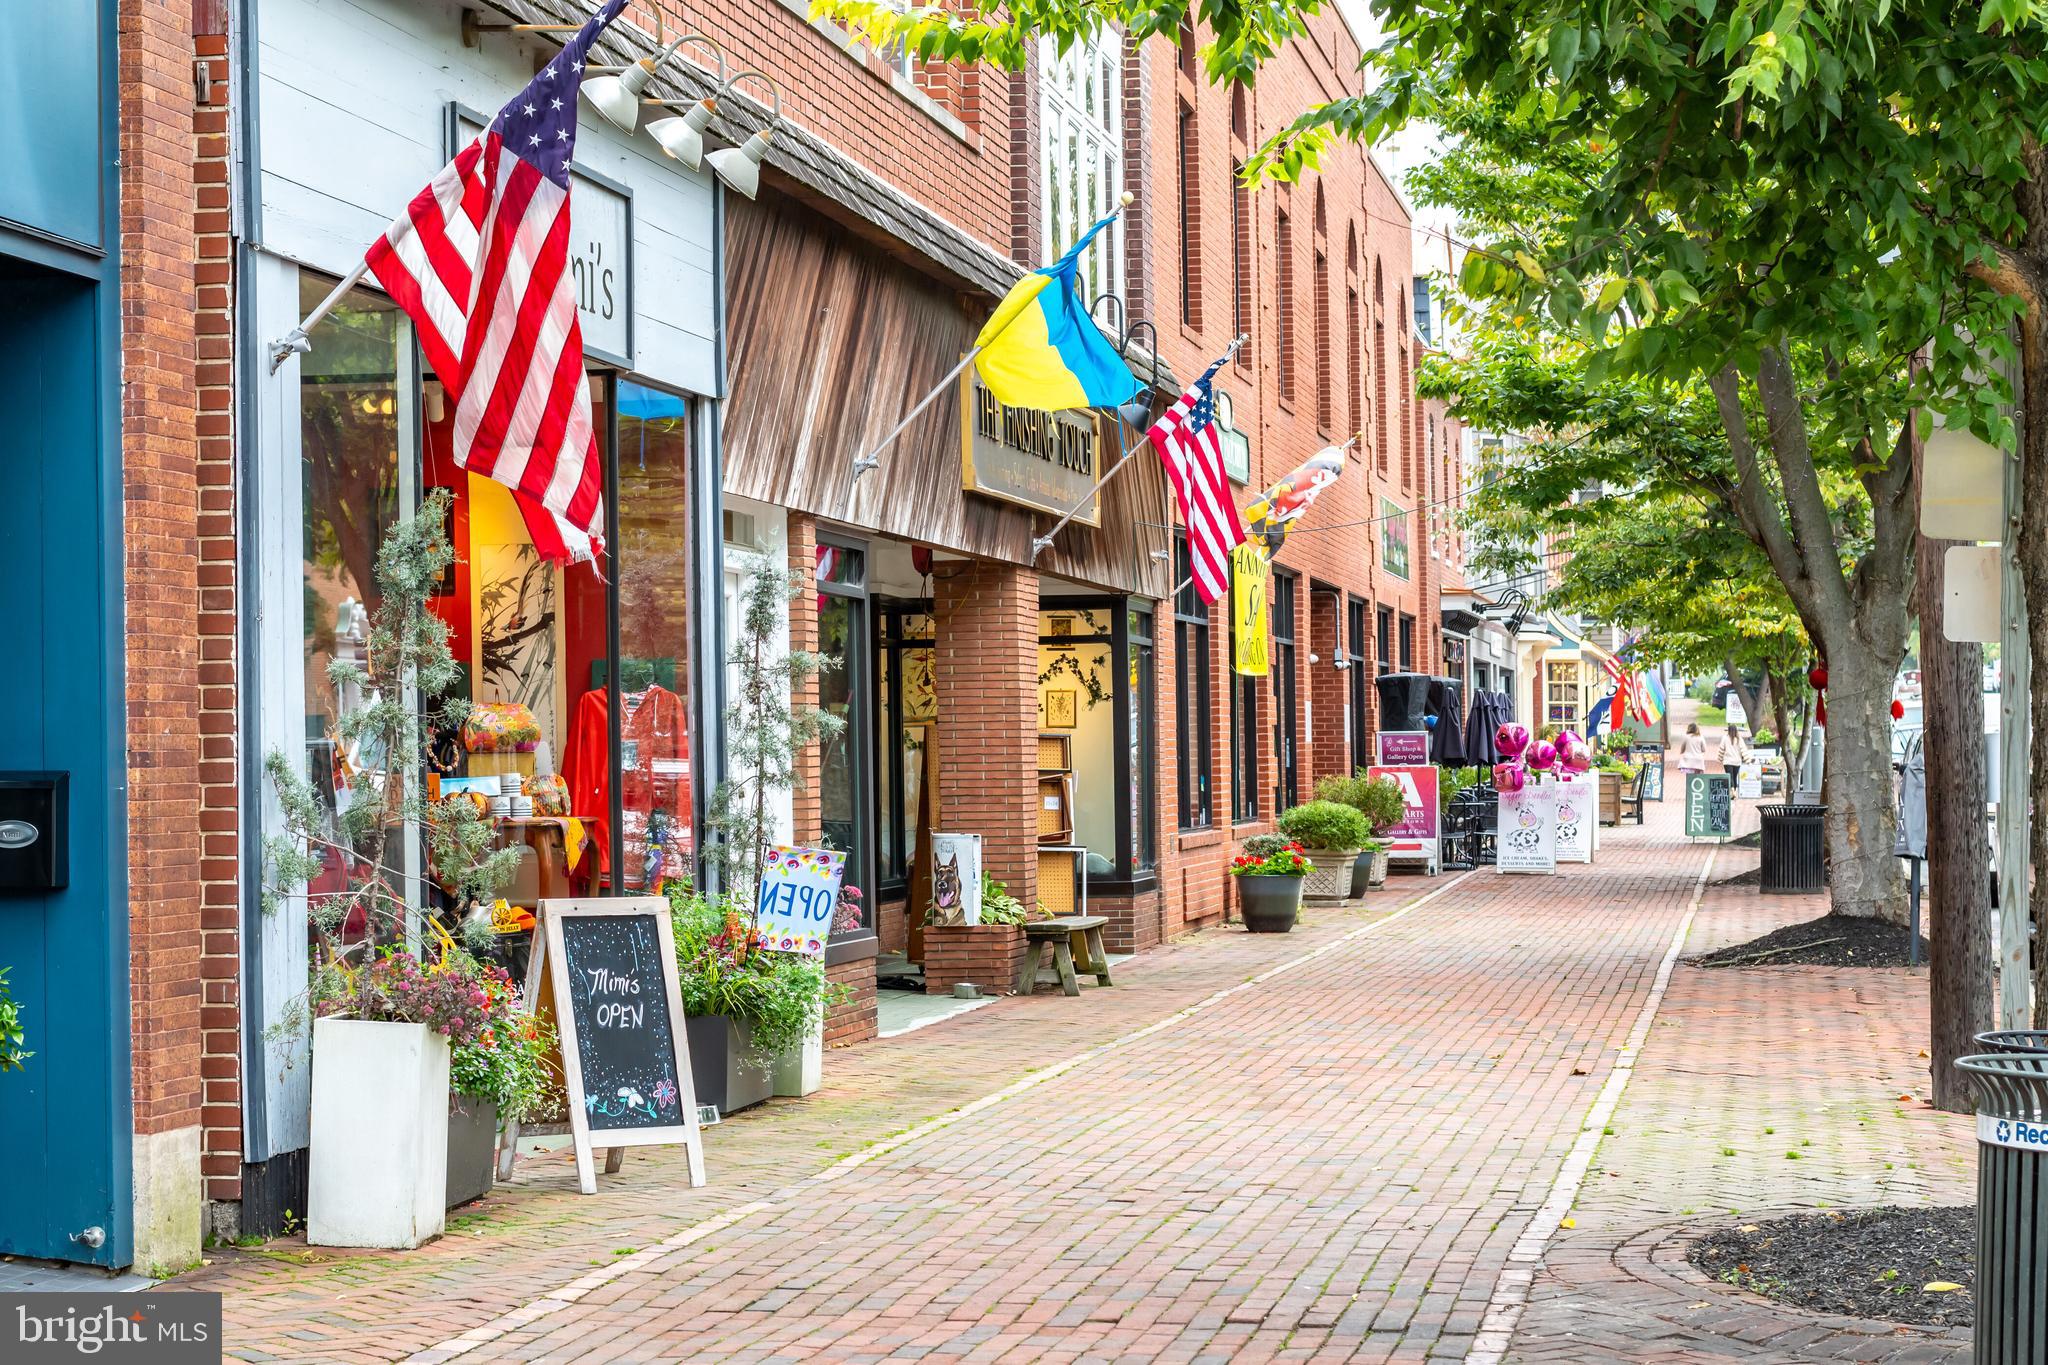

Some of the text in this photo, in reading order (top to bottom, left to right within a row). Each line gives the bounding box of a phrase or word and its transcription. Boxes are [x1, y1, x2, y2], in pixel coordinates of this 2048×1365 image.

[1057, 417, 1091, 476] TOUCH
[1690, 777, 1705, 832] OPEN
[1408, 827, 1412, 835] &
[587, 968, 640, 996] Mimi's
[597, 1002, 644, 1029] OPEN
[2016, 1122, 2048, 1145] Rec
